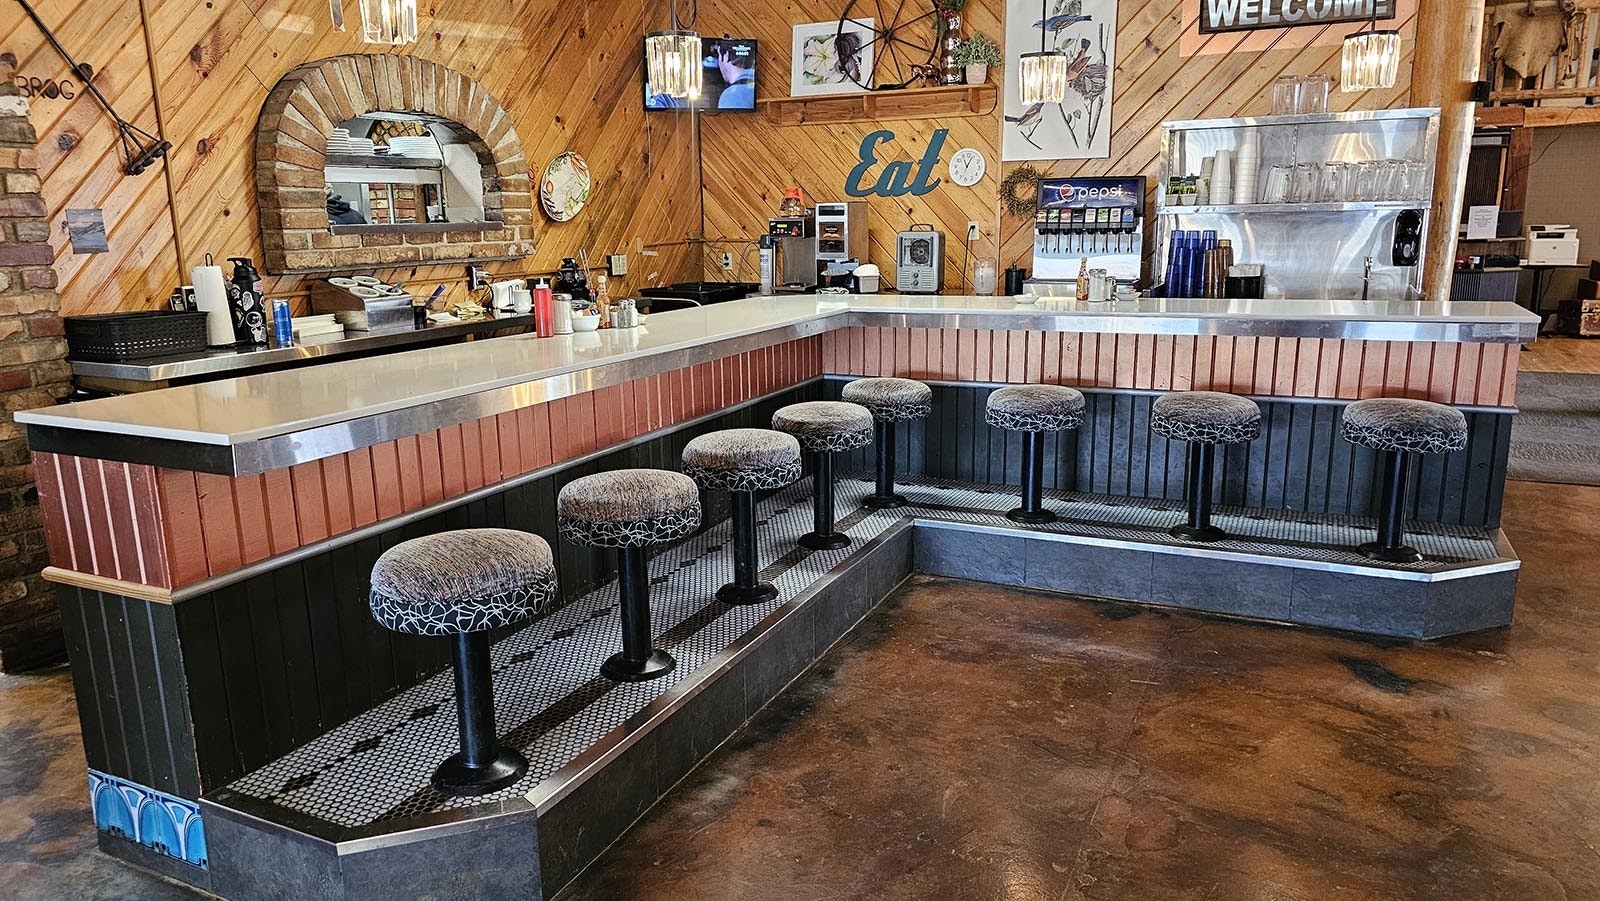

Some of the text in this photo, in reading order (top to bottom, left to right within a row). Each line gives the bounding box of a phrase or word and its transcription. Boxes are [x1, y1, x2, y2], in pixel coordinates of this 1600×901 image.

[16, 75, 75, 100] BROG
[844, 128, 949, 197] Eat
[1078, 184, 1122, 201] pepsi
